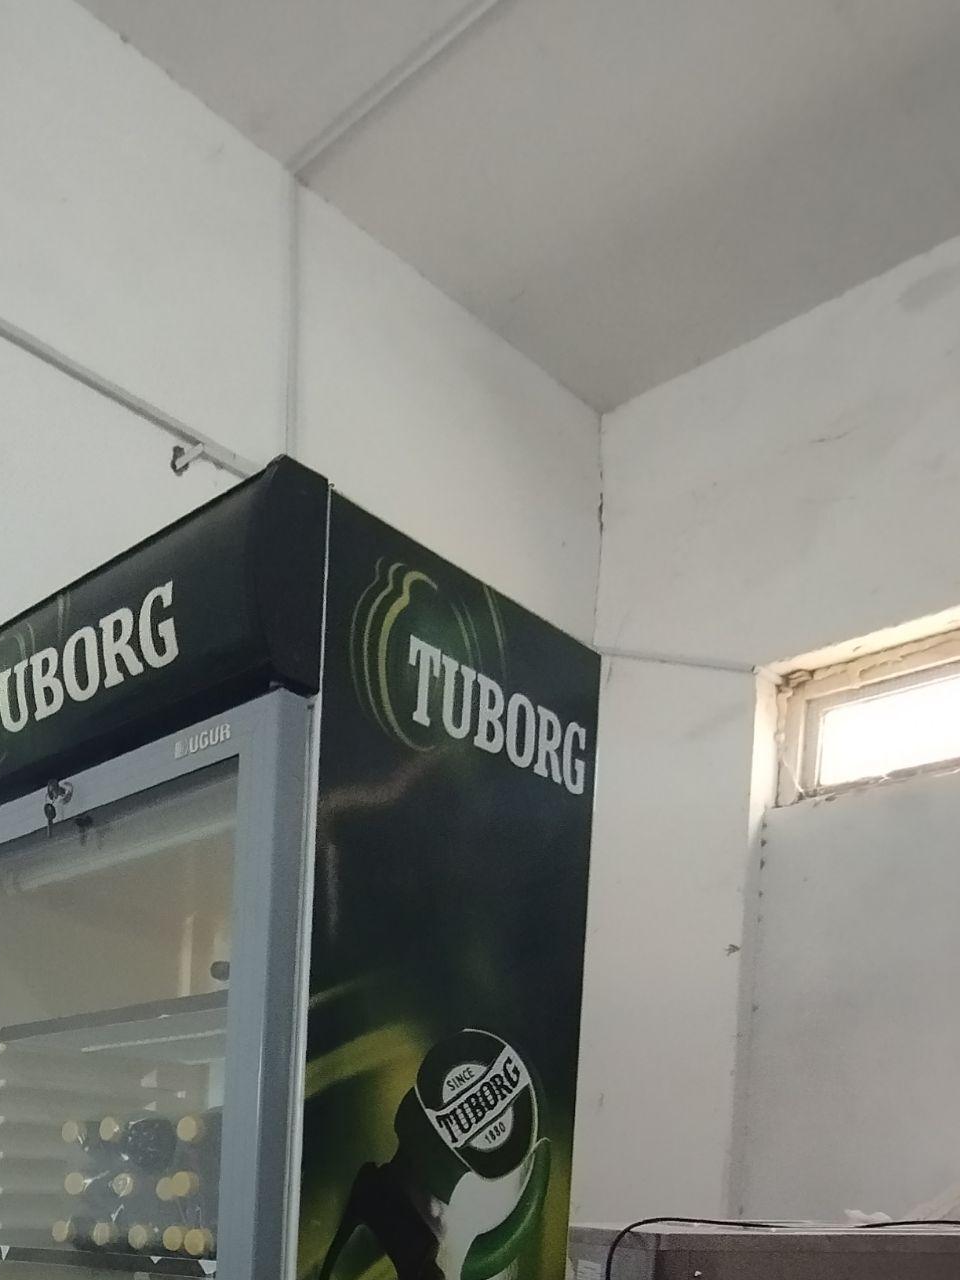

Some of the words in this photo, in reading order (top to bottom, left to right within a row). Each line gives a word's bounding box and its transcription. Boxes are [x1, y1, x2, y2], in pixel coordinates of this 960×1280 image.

[407, 634, 588, 796] TUBORG
[435, 1056, 521, 1144] TUBORG
[446, 1067, 476, 1092] SINCE
